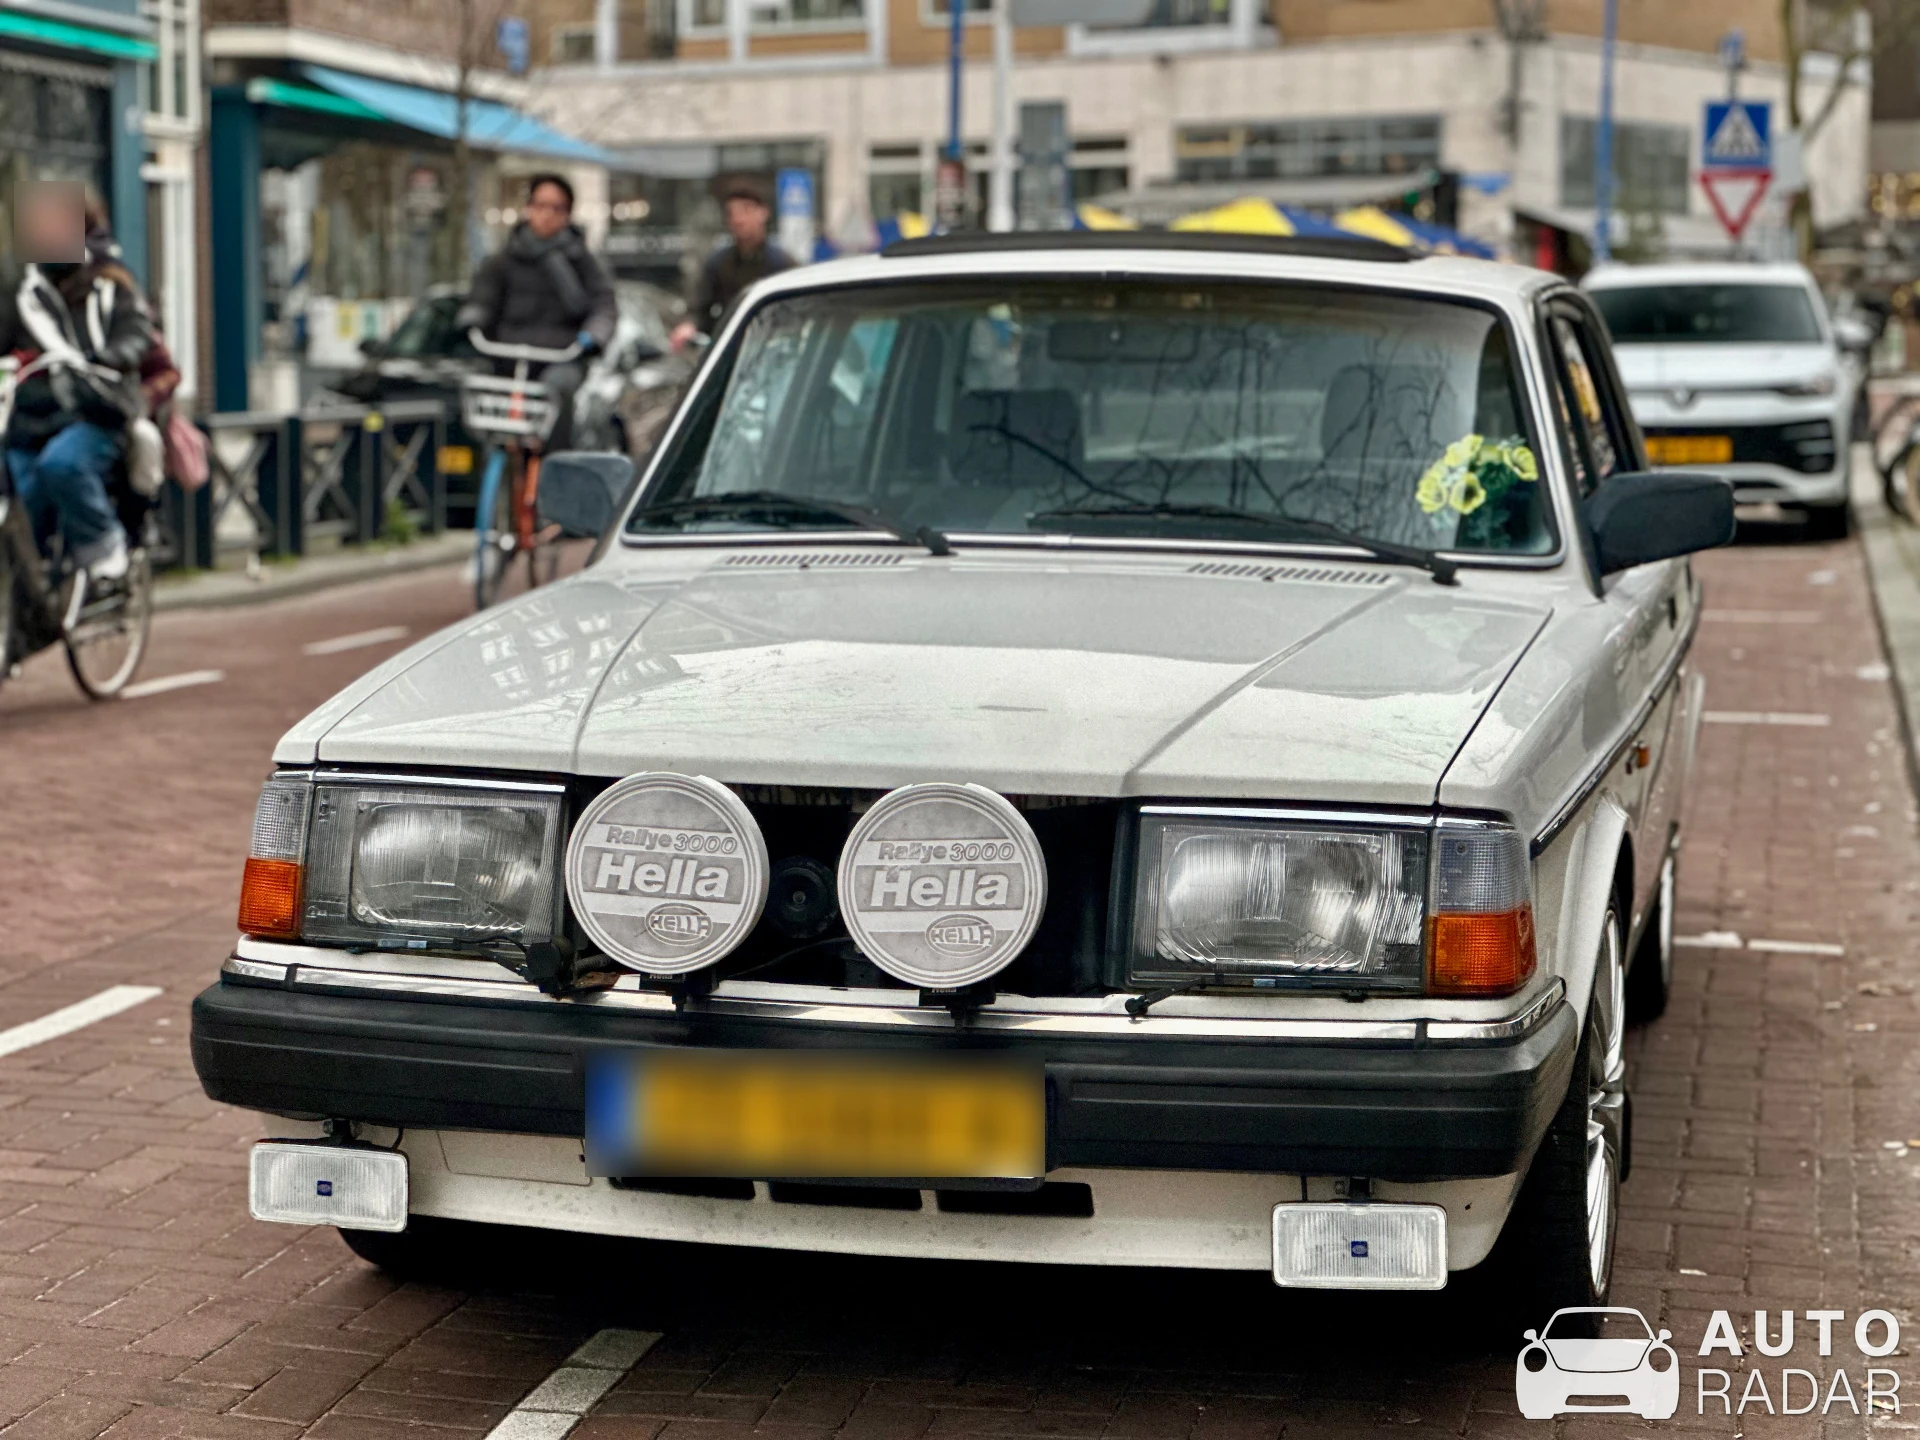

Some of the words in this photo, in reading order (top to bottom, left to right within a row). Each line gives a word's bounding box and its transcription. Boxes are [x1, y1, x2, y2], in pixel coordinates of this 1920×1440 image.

[606, 825, 672, 850] Rallye
[674, 833, 737, 854] 3000
[878, 842, 947, 863] Rallye
[950, 842, 1014, 862] 3000
[595, 852, 729, 898] Hella
[870, 868, 1009, 907] Hella
[651, 914, 711, 937] HELLA
[931, 925, 993, 947] HELLA
